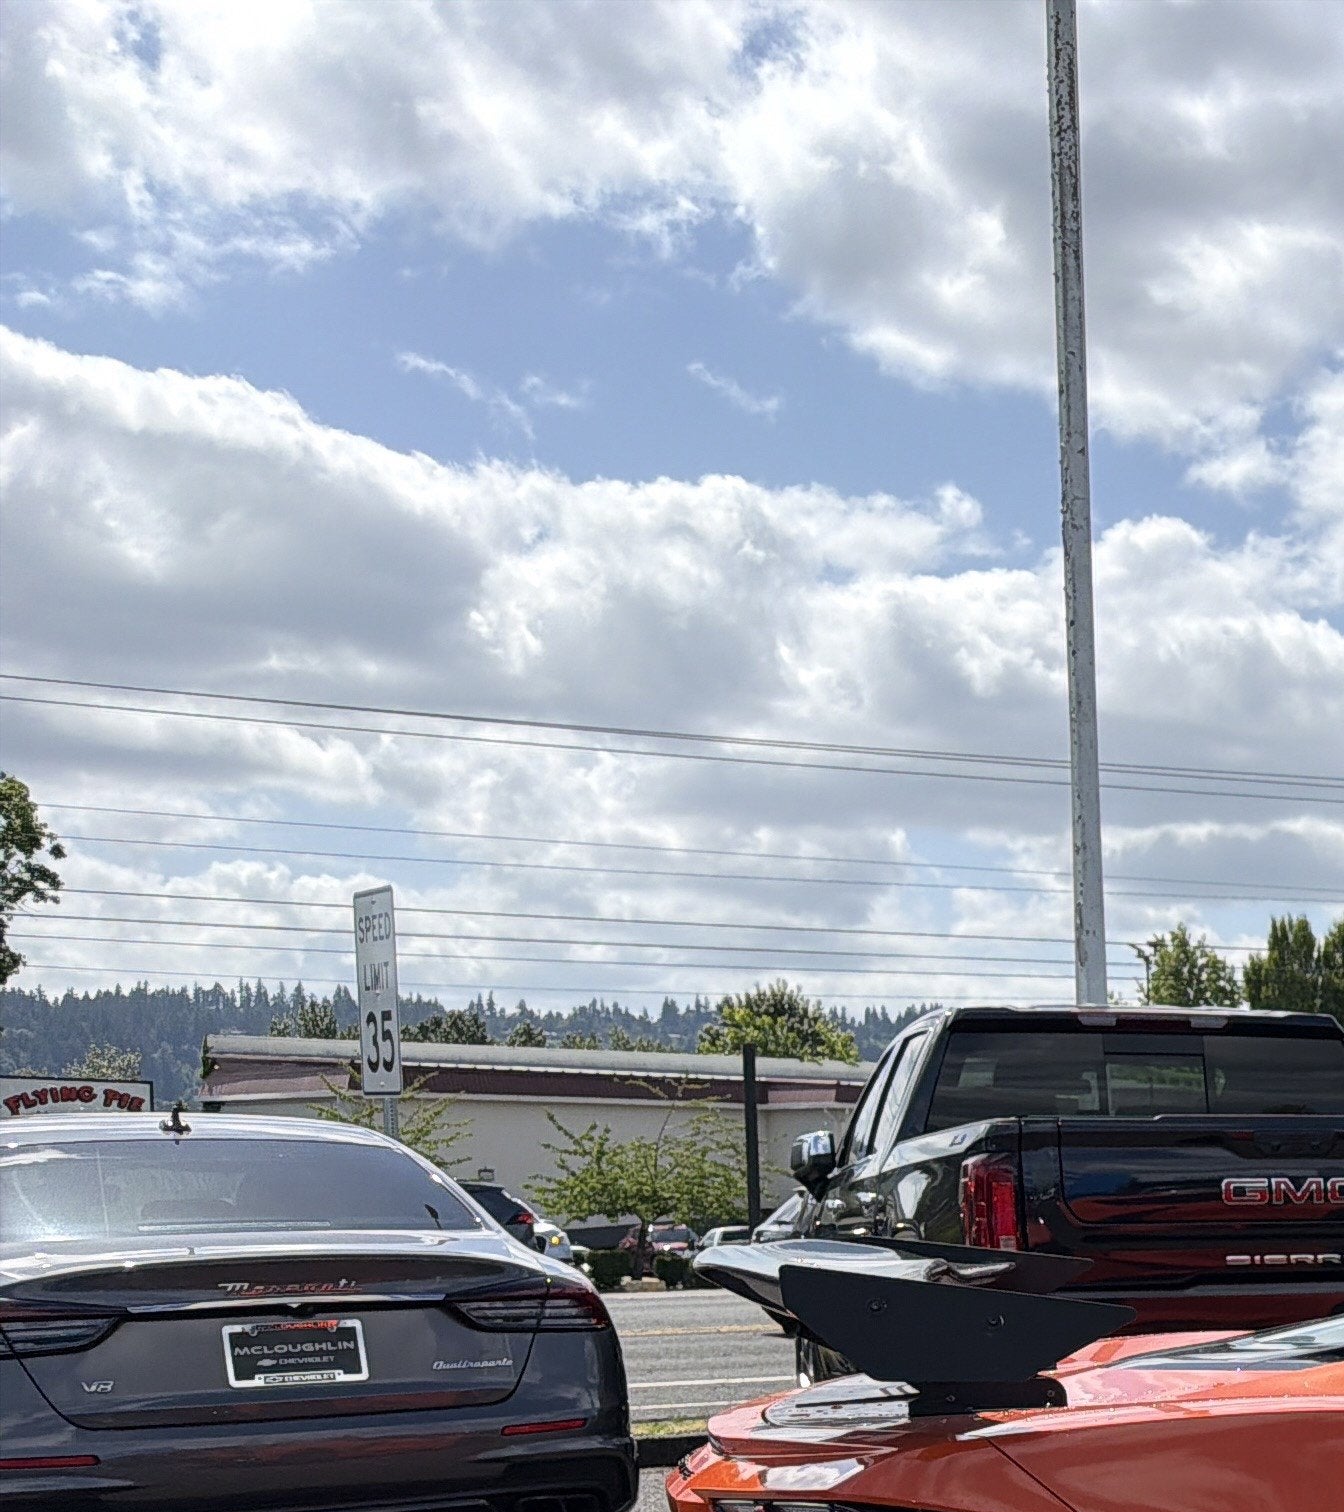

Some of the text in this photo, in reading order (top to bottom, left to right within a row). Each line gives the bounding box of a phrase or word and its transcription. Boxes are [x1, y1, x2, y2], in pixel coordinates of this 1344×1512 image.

[358, 912, 391, 943] SPEED
[363, 961, 389, 991] LIMIT
[366, 1010, 395, 1073] 35
[3, 1085, 145, 1115] FLYING PIE
[233, 1340, 355, 1357] MCLOUGHLIN
[278, 1355, 335, 1366] CHEVROLET
[81, 1380, 114, 1392] V8
